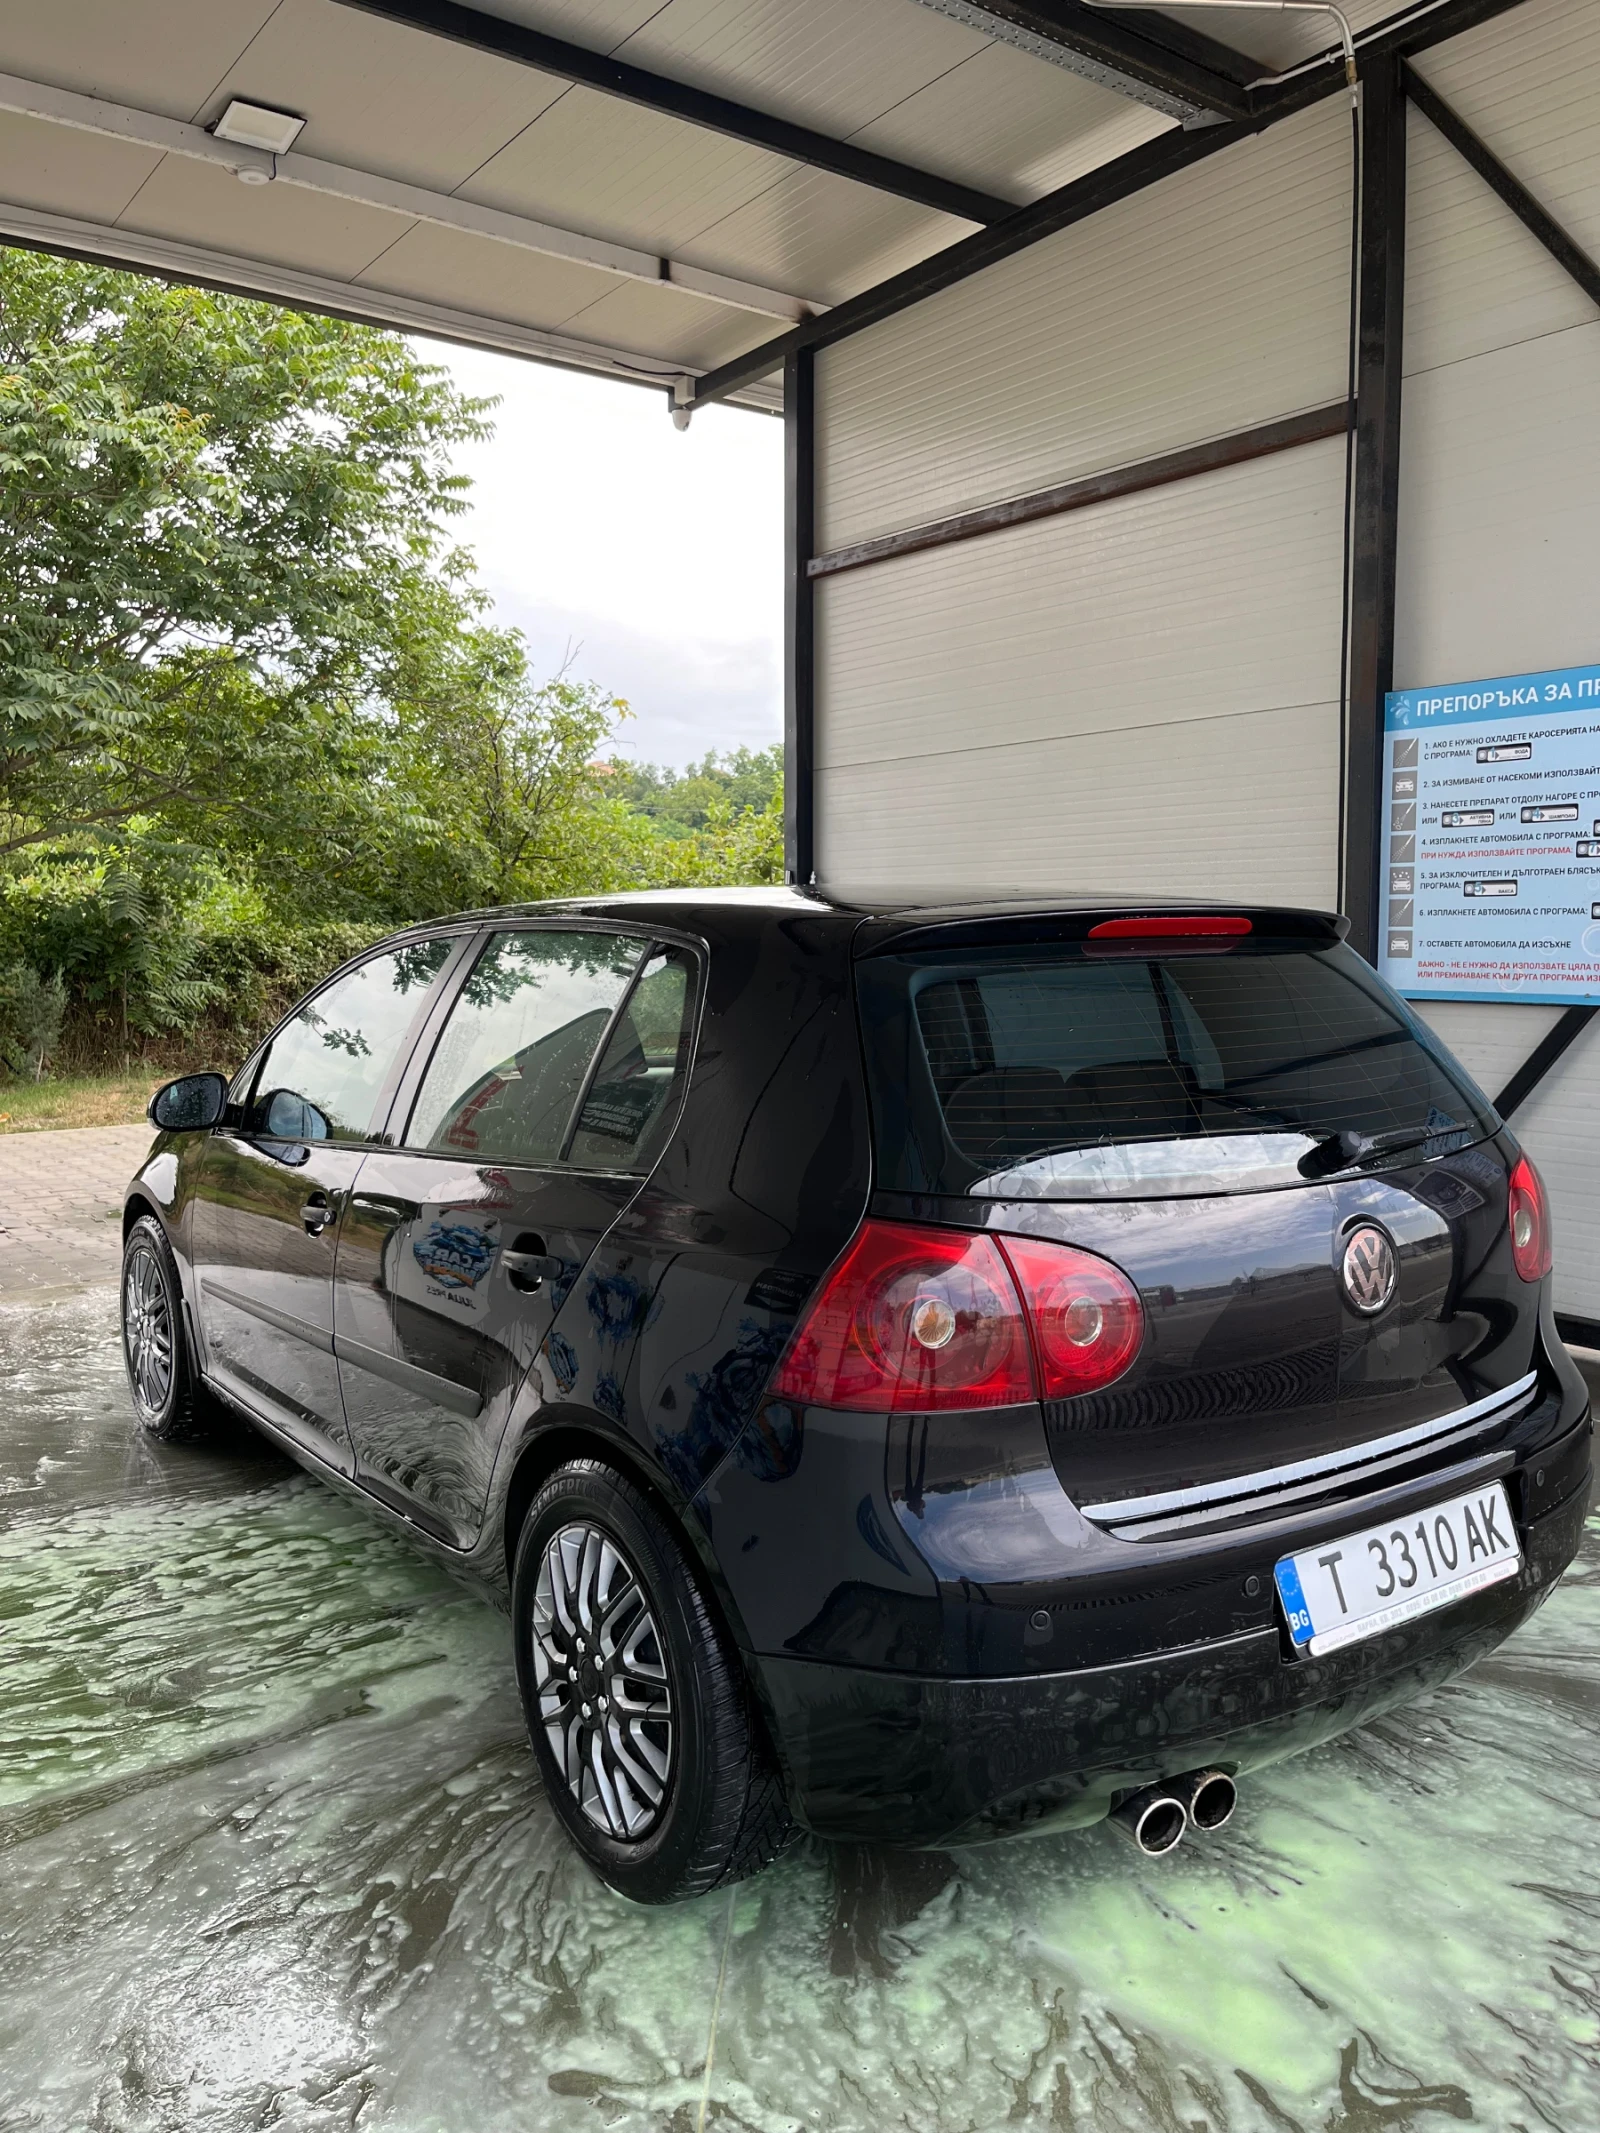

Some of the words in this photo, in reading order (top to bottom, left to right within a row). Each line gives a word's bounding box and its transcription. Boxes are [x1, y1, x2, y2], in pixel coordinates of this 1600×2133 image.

[1417, 687, 1538, 716] ПРЕПОРЪКА
[1544, 683, 1572, 701] ЗА
[1455, 737, 1484, 746] НУЖНО
[1485, 733, 1526, 743] ОХЛАДЕТЕ
[1529, 727, 1587, 739] КАРОСЕРИЯТА
[1431, 750, 1473, 759] ПРОГРАМА:
[1431, 780, 1441, 788] ЗА
[1443, 777, 1485, 786] ИЗМИВАНЕ
[1498, 771, 1542, 782] НАСЕКОМИ
[1430, 800, 1468, 809] НАНЕСЕТЕ
[1470, 797, 1510, 807] ПРЕПАРАТ
[1511, 795, 1543, 804] ОТДОЛУ
[1545, 792, 1578, 801] НАГОРЕ
[1499, 812, 1516, 820] ИЛИ
[1429, 836, 1478, 845] ИЗПЛАКНЕТЕ
[1480, 833, 1534, 843] АВТОМОБИЛА
[1543, 831, 1591, 840] ПРОГРАМА:
[1438, 851, 1466, 859] НУЖДА
[1467, 848, 1524, 857] ИЗПОЛЗВАЙТЕ
[1526, 847, 1573, 855] ПРОГРАМА:
[1440, 870, 1503, 878] ИЗКЛЮЧИТЕЛЕН
[1511, 868, 1565, 877] ДЪЛГОТРАЕН
[1478, 908, 1531, 916] АВТОМОБИЛА
[1464, 940, 1517, 948] АВТОМОБИЛА
[1518, 941, 1530, 949] ДА
[1499, 962, 1511, 970] ДА
[1512, 962, 1566, 970] ИЗПОЛЗВАТЕ
[1568, 963, 1592, 972] ЦЯЛА
[1512, 973, 1538, 981] ДРУГА
[1540, 974, 1585, 982] ПРОГРАМА
[1318, 1551, 1348, 1614] T
[1367, 1514, 1458, 1597] 3310
[1463, 1495, 1511, 1563] AK
[1289, 1610, 1310, 1631] BG
